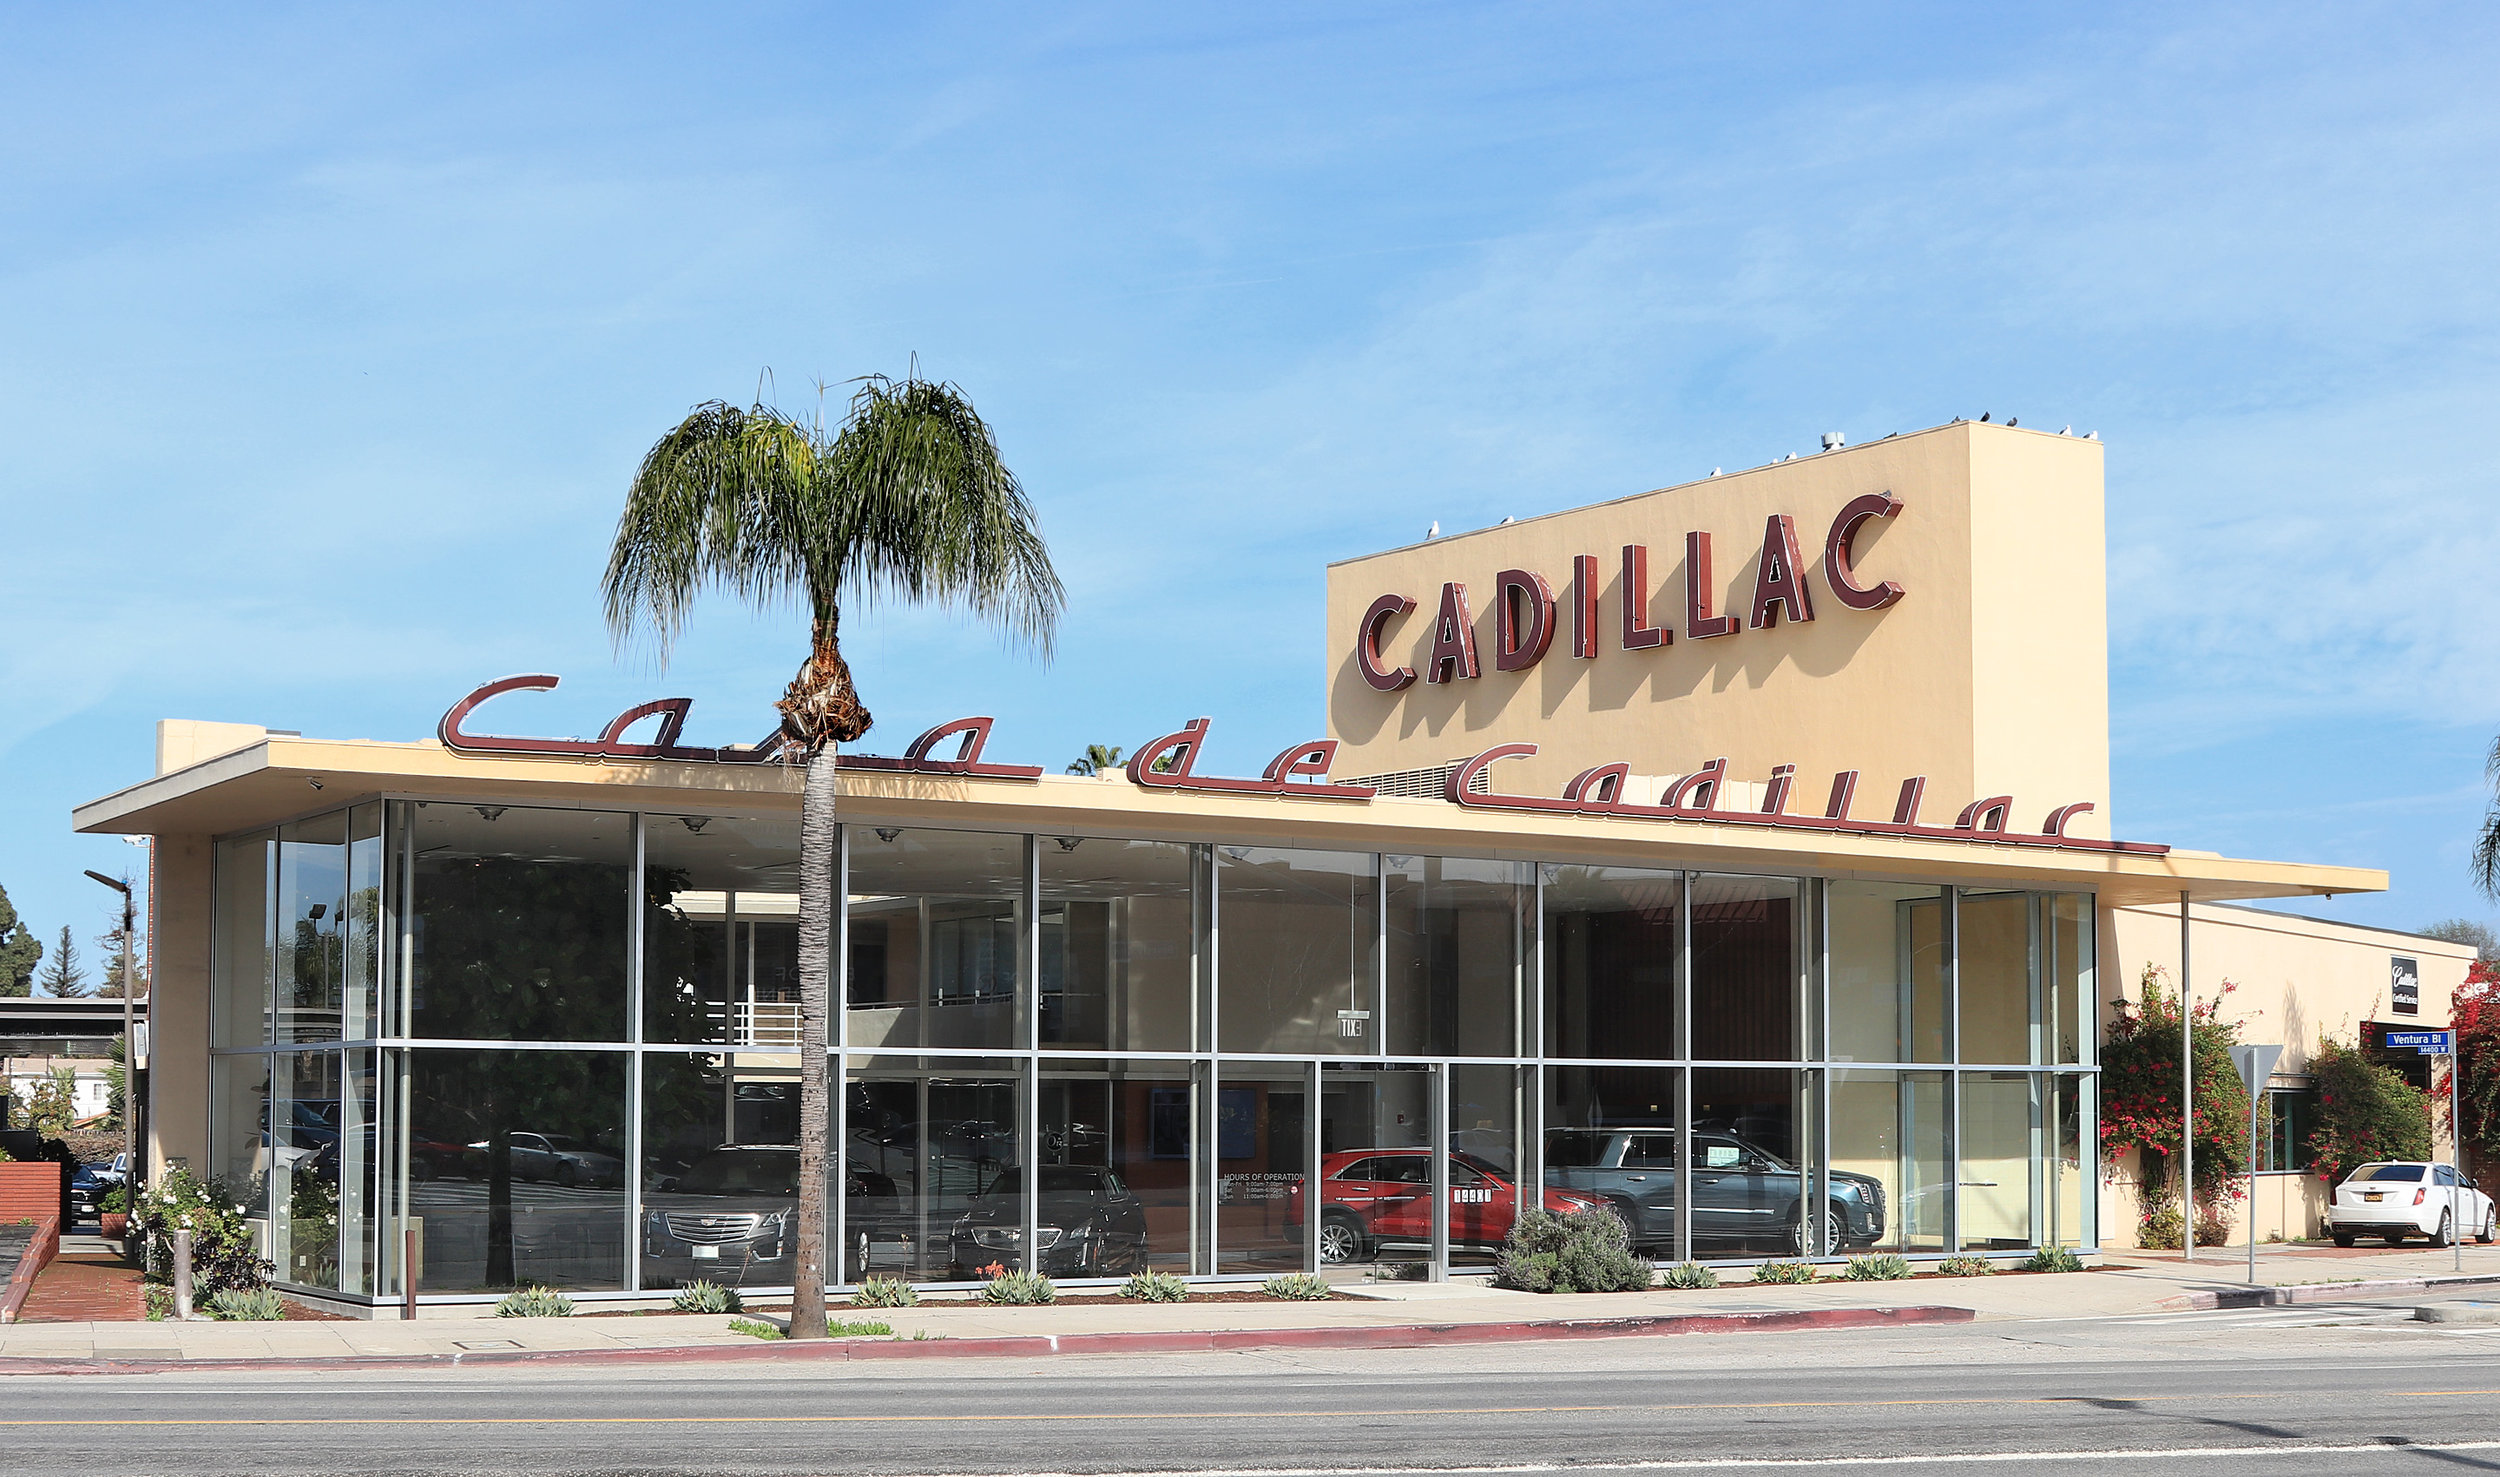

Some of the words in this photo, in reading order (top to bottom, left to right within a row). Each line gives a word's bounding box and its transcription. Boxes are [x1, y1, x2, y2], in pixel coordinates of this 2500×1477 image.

[1356, 493, 1906, 692] CADILLAC
[1126, 715, 1378, 803] de
[1445, 742, 2171, 856] Cadillac
[2393, 1034, 2429, 1045] Ventura
[1224, 1173, 1250, 1181] HOURS
[1251, 1173, 1262, 1181] OF
[1263, 1173, 1305, 1181] OPERATION
[1455, 1190, 1490, 1201] 14401
